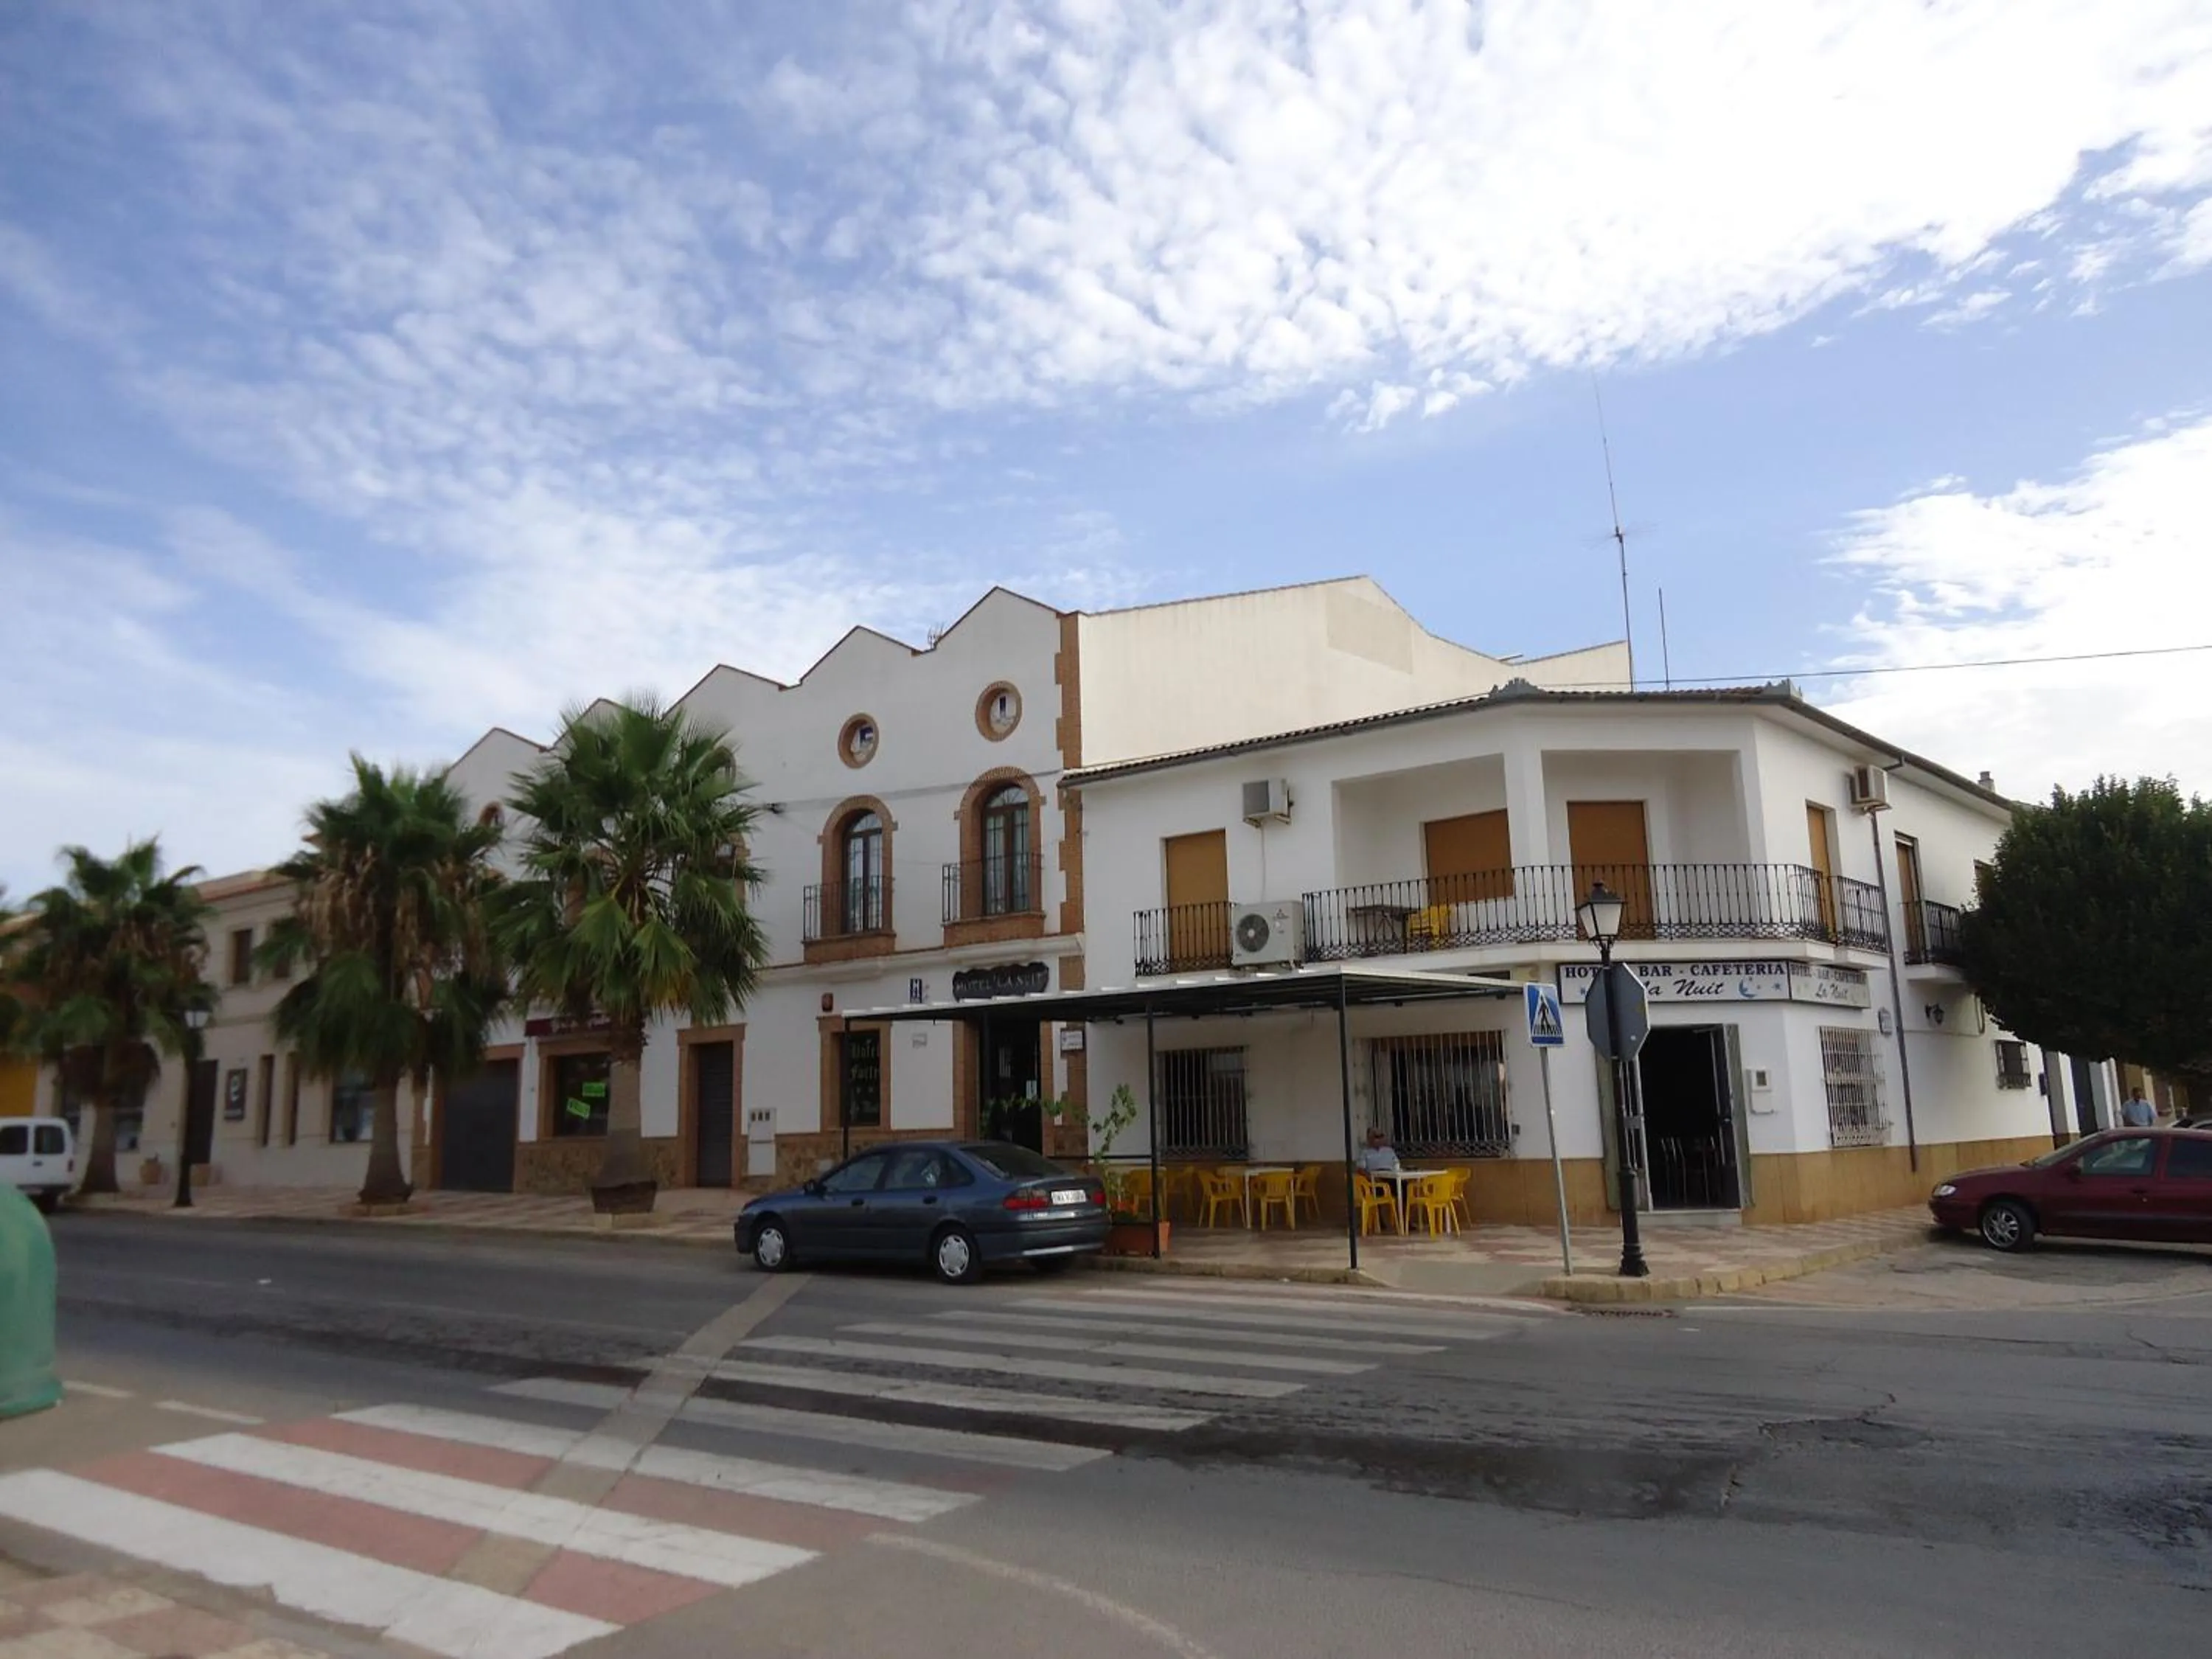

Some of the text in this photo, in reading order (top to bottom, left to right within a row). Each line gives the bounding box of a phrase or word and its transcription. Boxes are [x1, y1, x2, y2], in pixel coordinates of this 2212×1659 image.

[1565, 964, 1785, 978] HOT BAR CAFETERIA
[1673, 978, 1725, 997] Nuit
